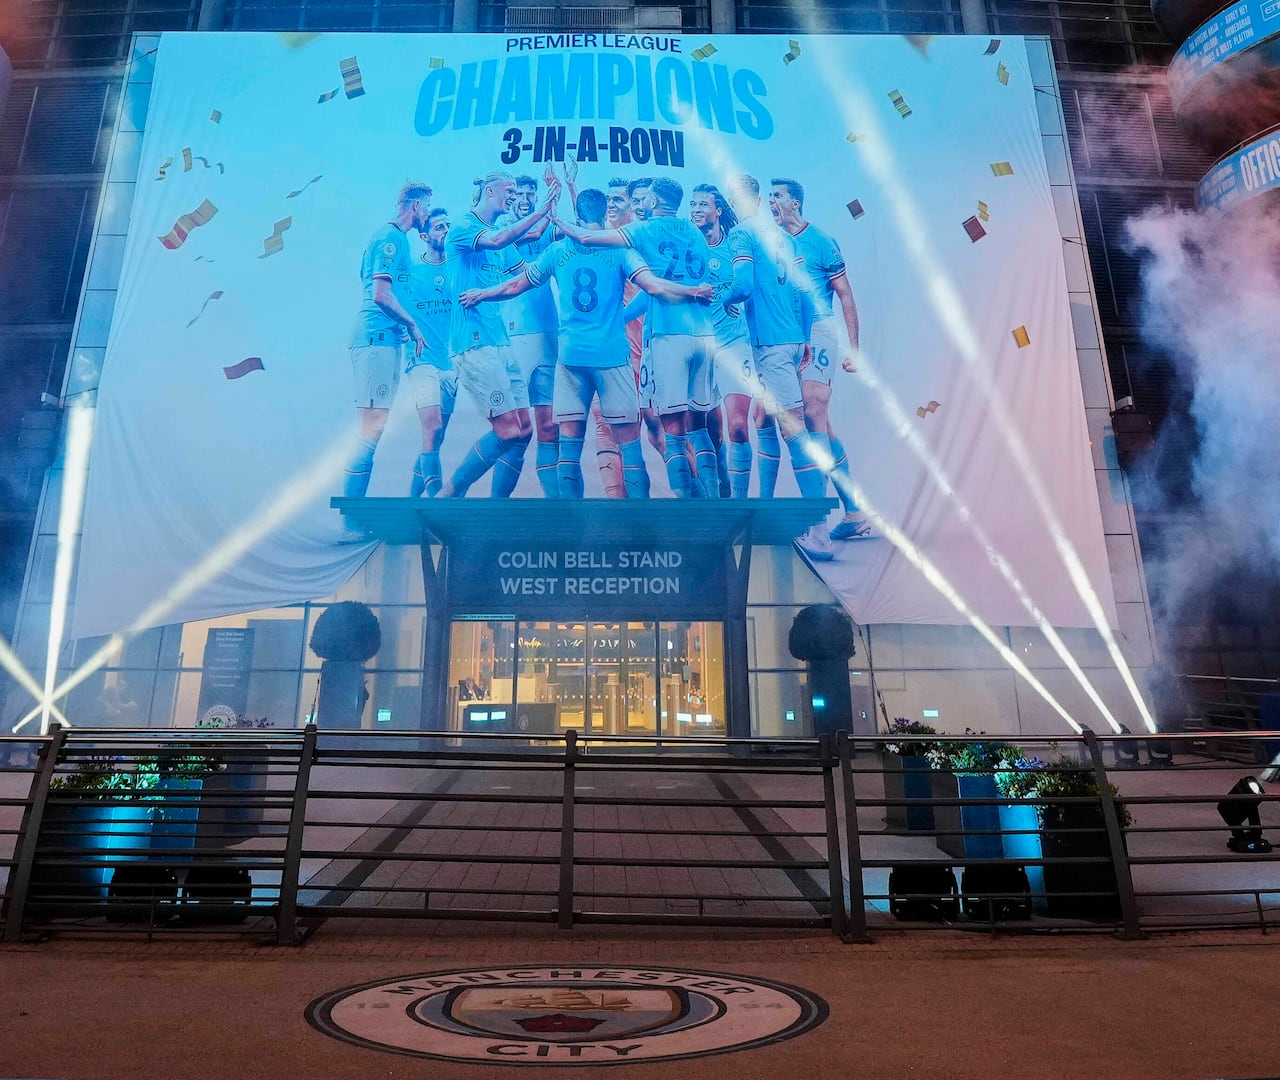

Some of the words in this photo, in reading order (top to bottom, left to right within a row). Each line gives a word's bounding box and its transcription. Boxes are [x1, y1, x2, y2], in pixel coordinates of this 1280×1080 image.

[506, 33, 596, 52] PREMIER
[603, 34, 683, 53] LEAGUE
[414, 52, 774, 140] CHAMPIONS
[500, 126, 684, 168] 3-IN-A-ROW
[572, 267, 598, 313] 8
[498, 551, 557, 568] COLIN
[564, 551, 612, 568] BELL
[618, 551, 682, 568] STAND
[500, 577, 558, 595] WEST
[564, 577, 680, 595] RECEPTION
[382, 969, 756, 996] MANCHESTER
[486, 1043, 644, 1058] CITY
